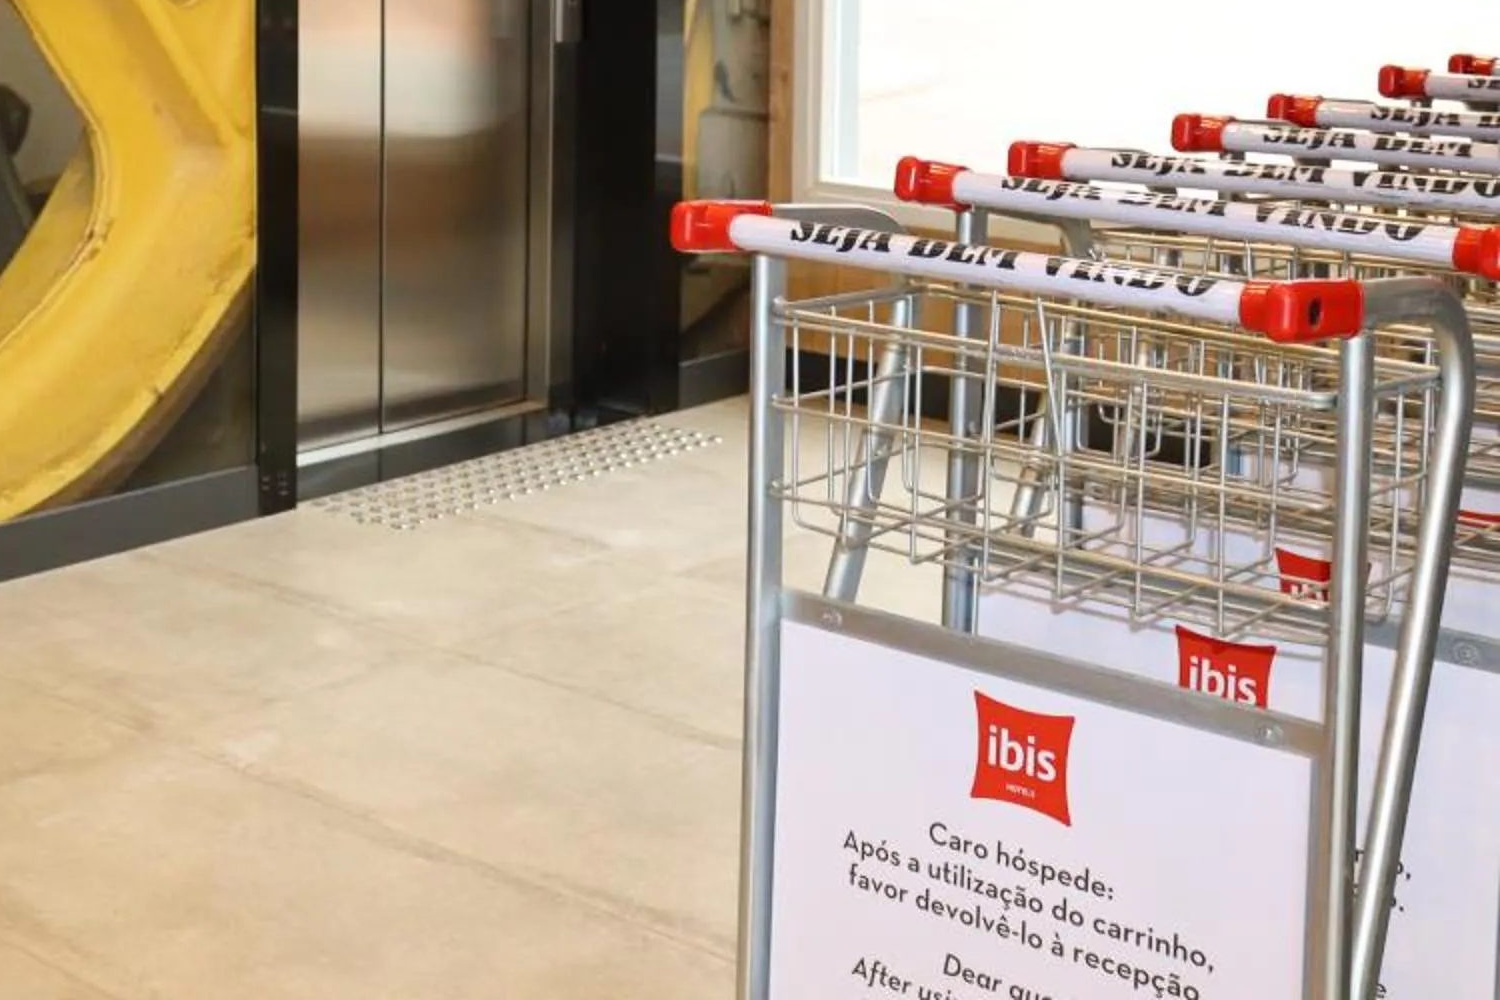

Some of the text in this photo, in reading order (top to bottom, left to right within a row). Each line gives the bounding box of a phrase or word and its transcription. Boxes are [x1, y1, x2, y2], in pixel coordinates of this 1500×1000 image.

[1189, 656, 1257, 705] ibis
[988, 724, 1056, 782] ibis
[929, 821, 1114, 901] Caro hóspede:
[843, 830, 1214, 973] Após a utilização do carrinho,
[849, 863, 1199, 1000] favor devolvê-lo à recepção
[851, 957, 913, 995] After
[943, 953, 1002, 992] Dear
